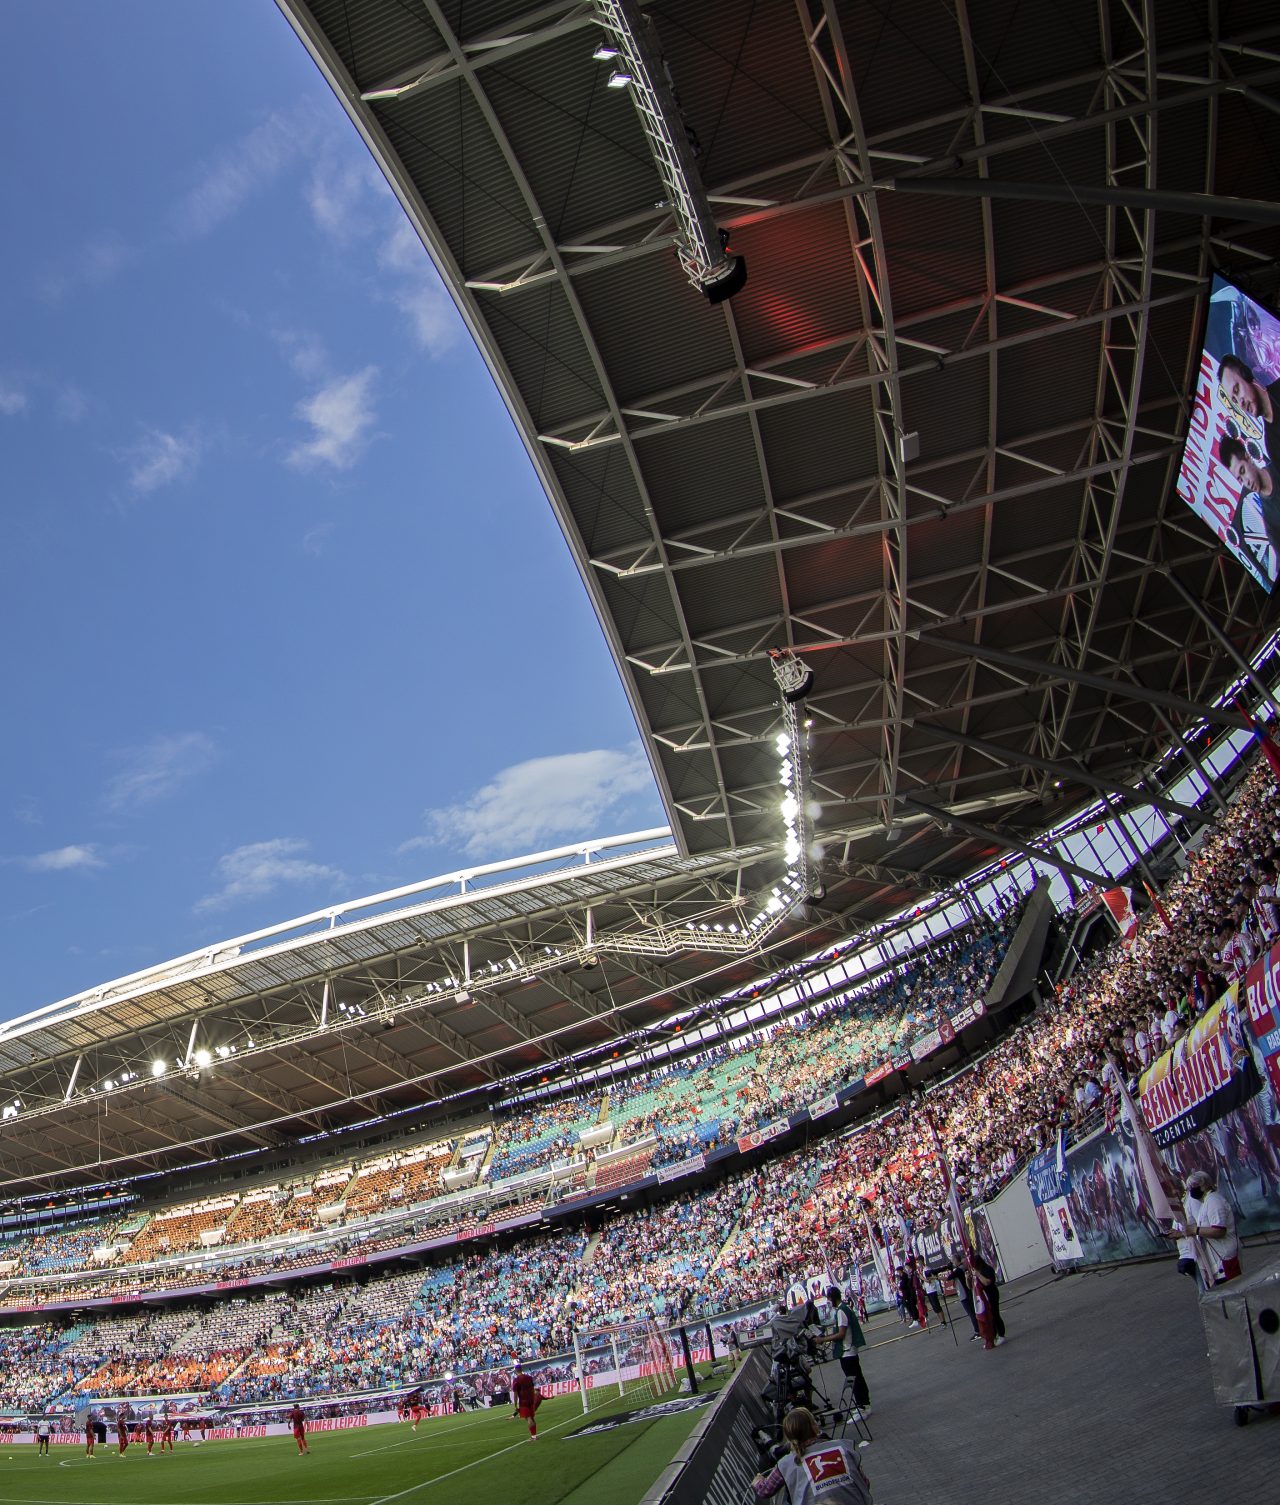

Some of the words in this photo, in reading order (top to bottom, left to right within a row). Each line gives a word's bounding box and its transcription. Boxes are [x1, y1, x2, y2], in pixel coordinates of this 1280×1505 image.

[1140, 1032, 1232, 1132] BENNEWITZ
[334, 1415, 367, 1430] LEIPZIG
[815, 1475, 853, 1491] BUNDESLIGA
